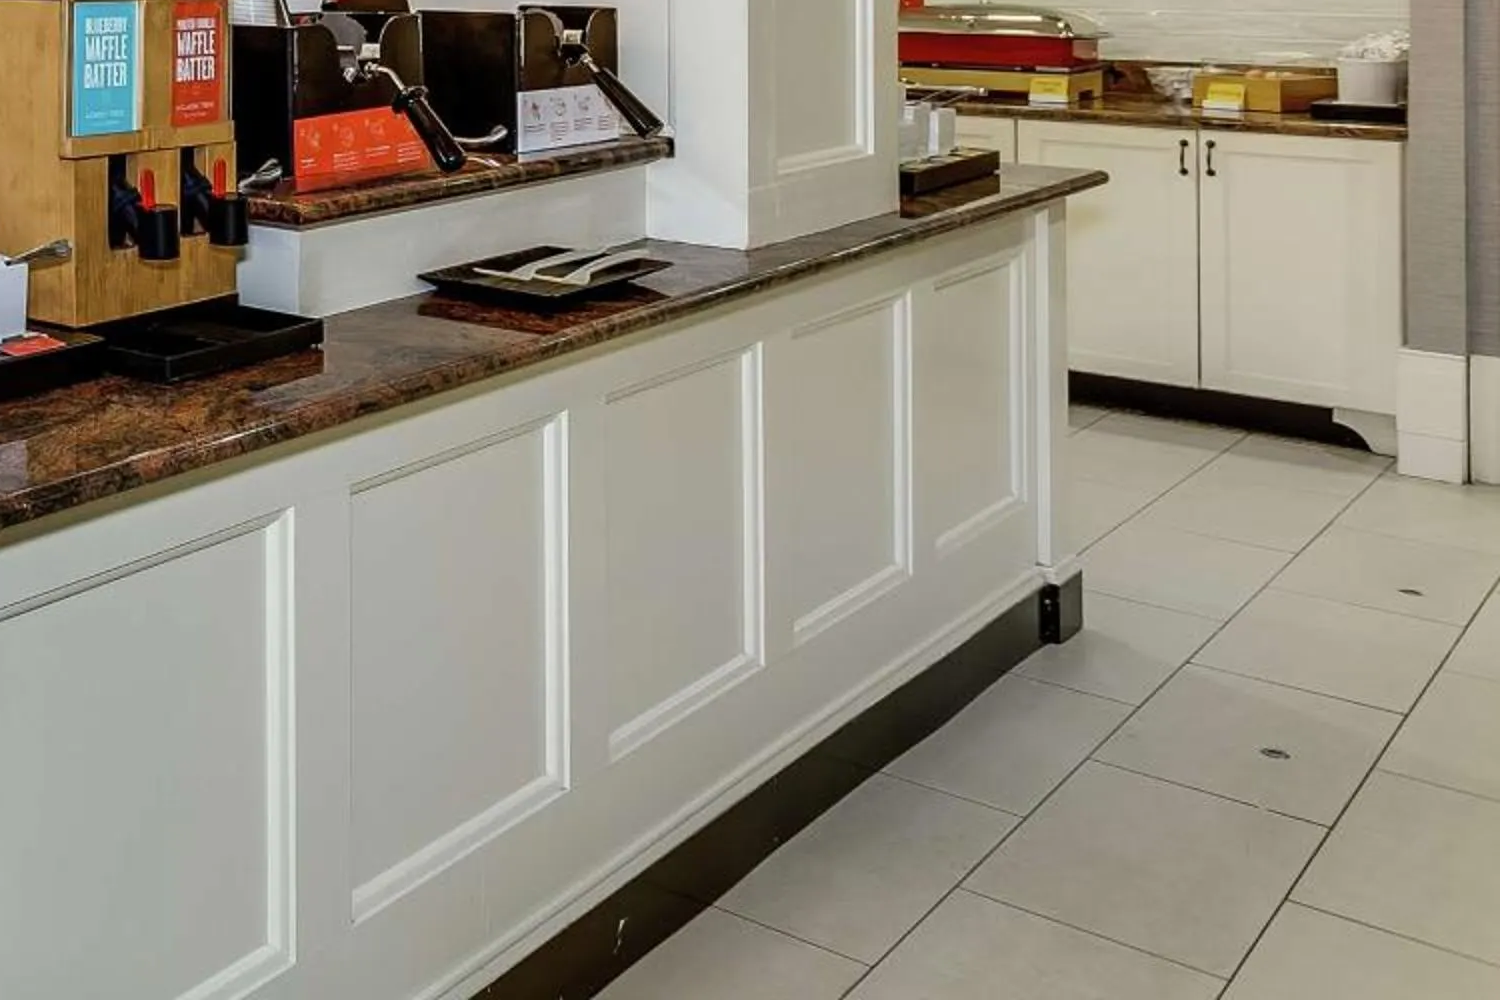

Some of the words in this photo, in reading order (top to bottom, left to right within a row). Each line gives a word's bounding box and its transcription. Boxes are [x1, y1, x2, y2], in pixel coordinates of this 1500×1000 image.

[85, 16, 128, 34] BLUEBERRY
[85, 34, 128, 62] WAFFLE
[176, 30, 216, 58] WAFFLE
[84, 61, 128, 89] BATTER
[175, 56, 216, 82] BATTER
